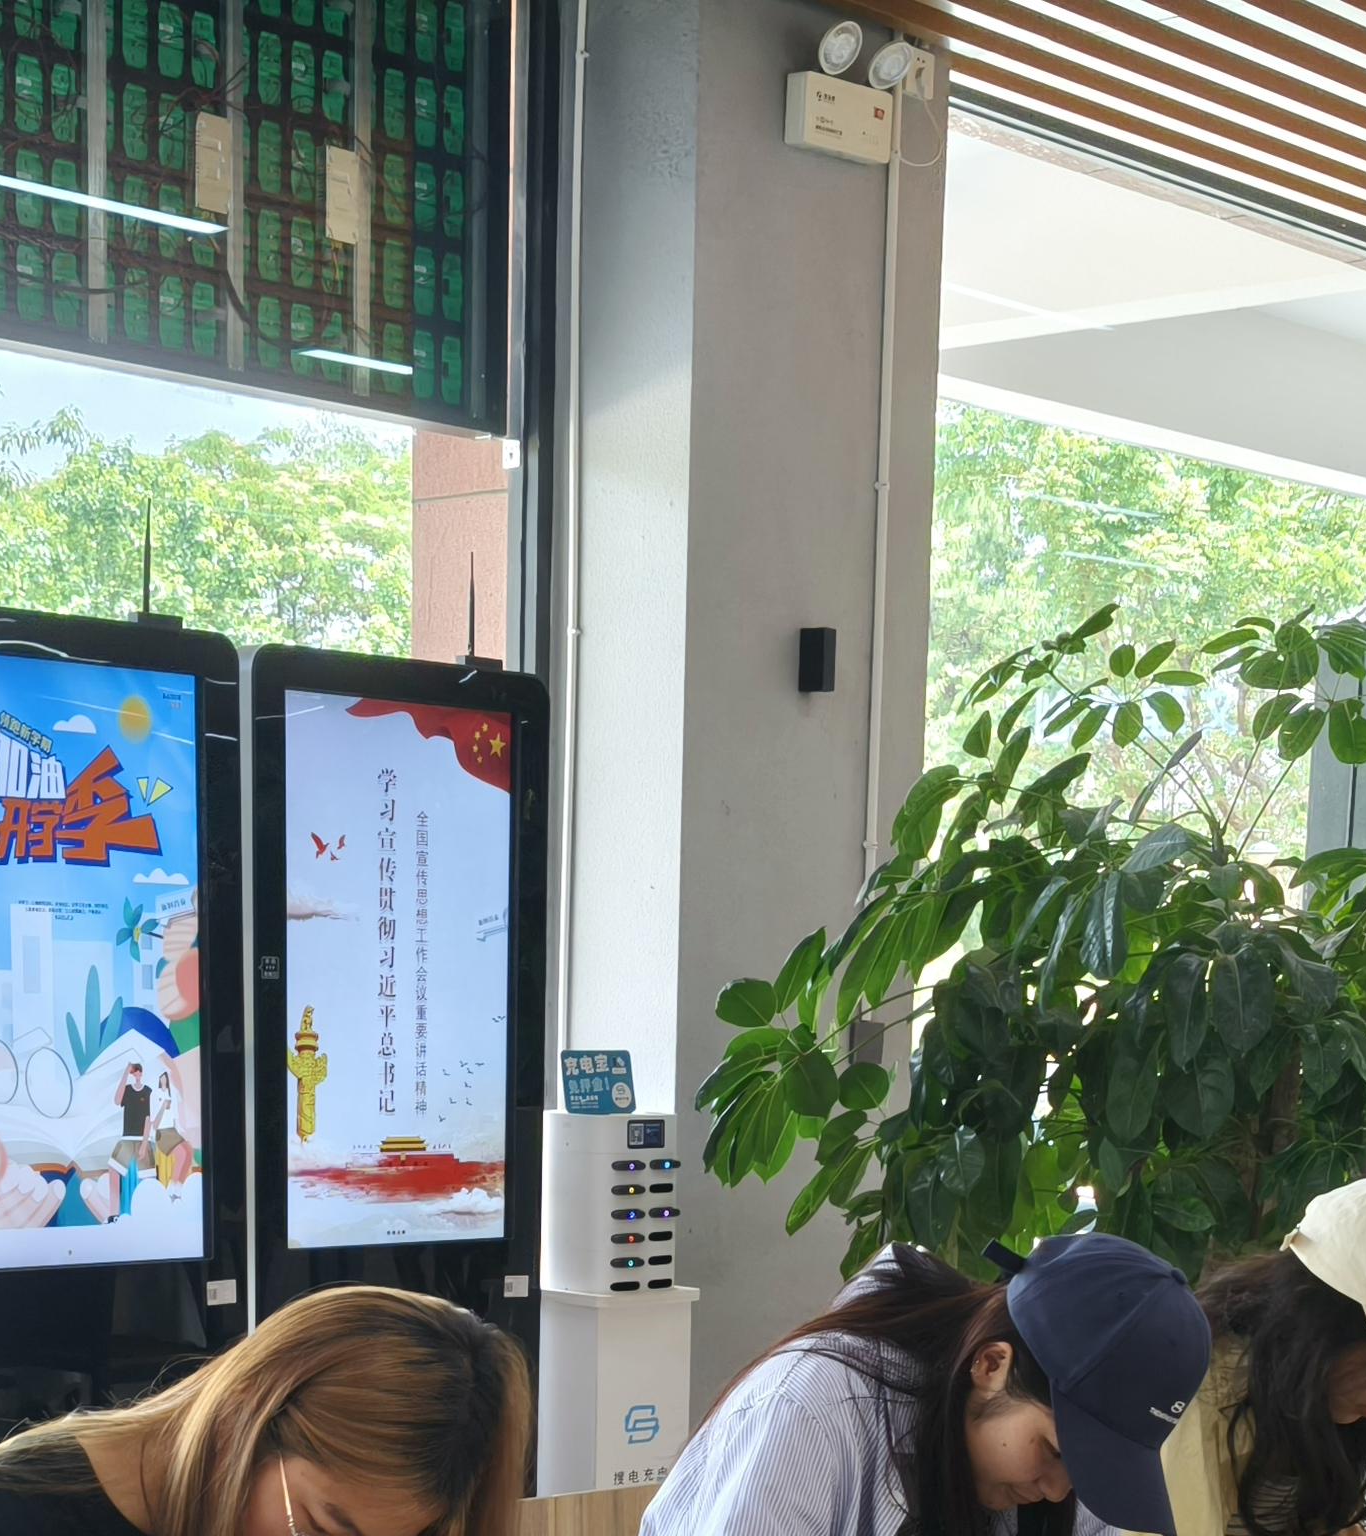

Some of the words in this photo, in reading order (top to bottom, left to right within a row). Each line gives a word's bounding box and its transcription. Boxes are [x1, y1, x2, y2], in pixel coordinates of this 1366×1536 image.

[377, 767, 397, 1115] 学习宣传贯彻习近平总书记
[414, 811, 429, 1115] 全国宣传思想工作会议重要讲话精神
[564, 1054, 610, 1076] 充电宝
